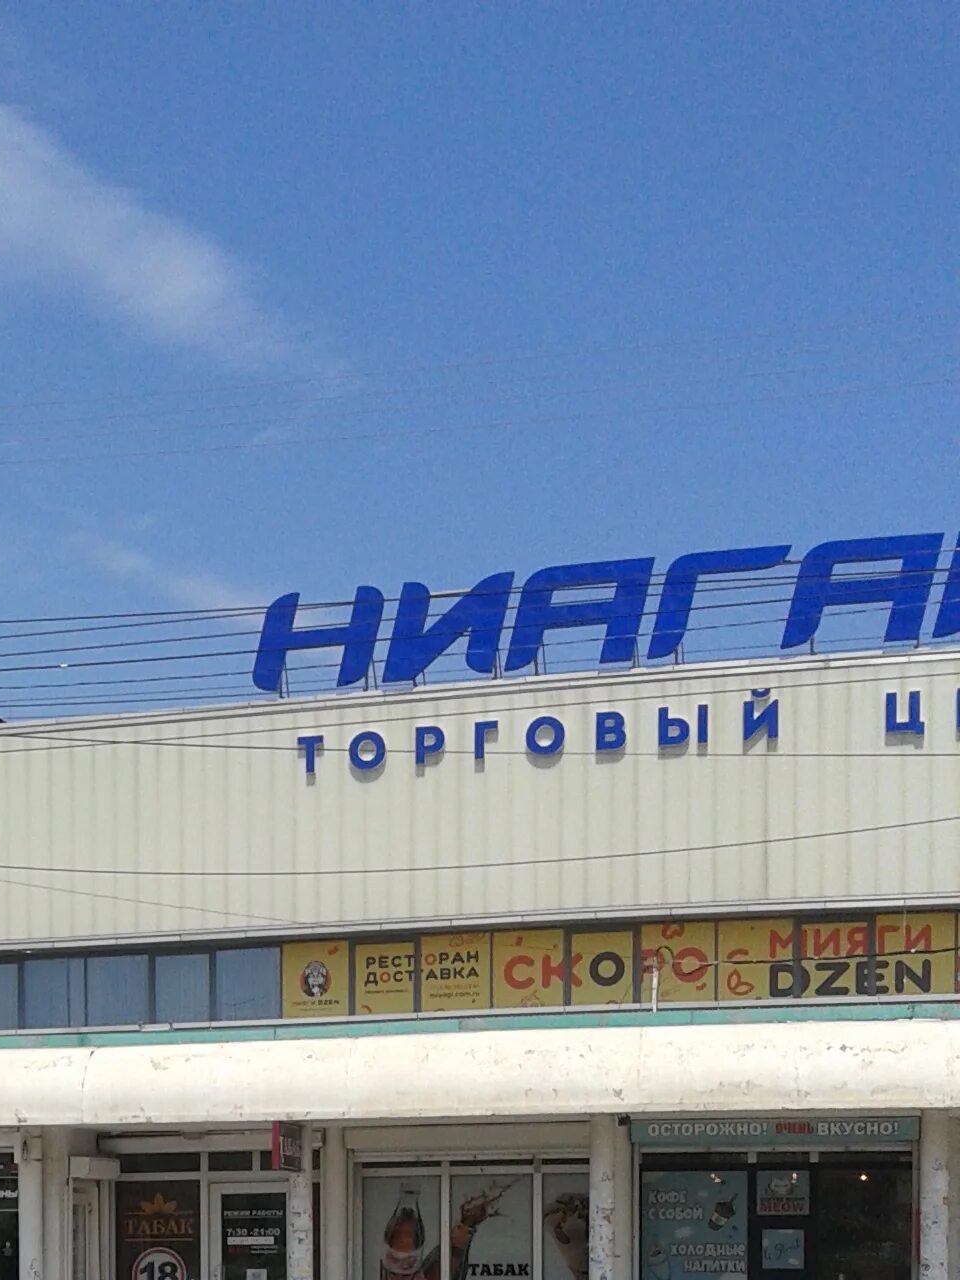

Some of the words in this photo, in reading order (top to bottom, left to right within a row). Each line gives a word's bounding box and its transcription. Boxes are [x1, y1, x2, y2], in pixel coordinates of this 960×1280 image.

[252, 532, 960, 691] НИАГА
[297, 687, 780, 774] ТОРГОВЫЙ
[885, 690, 960, 736] Ц
[769, 924, 933, 959] МИЯГИ
[365, 950, 480, 970] РЕСТОРАН
[364, 966, 480, 987] ДОСТАВКА
[769, 959, 932, 998] DZEN
[647, 1122, 768, 1137] ОСТОРОЖНО!
[817, 1121, 899, 1136] ВКУСНО!
[648, 1190, 687, 1203] КОФЕ
[658, 1204, 704, 1219] СОБОЙ
[126, 1219, 193, 1235] ТАБАК
[670, 1243, 745, 1256] ХОЛОДНЫЕ
[469, 1263, 529, 1276] ТАБАК
[683, 1259, 745, 1272] НАПИТКИ
